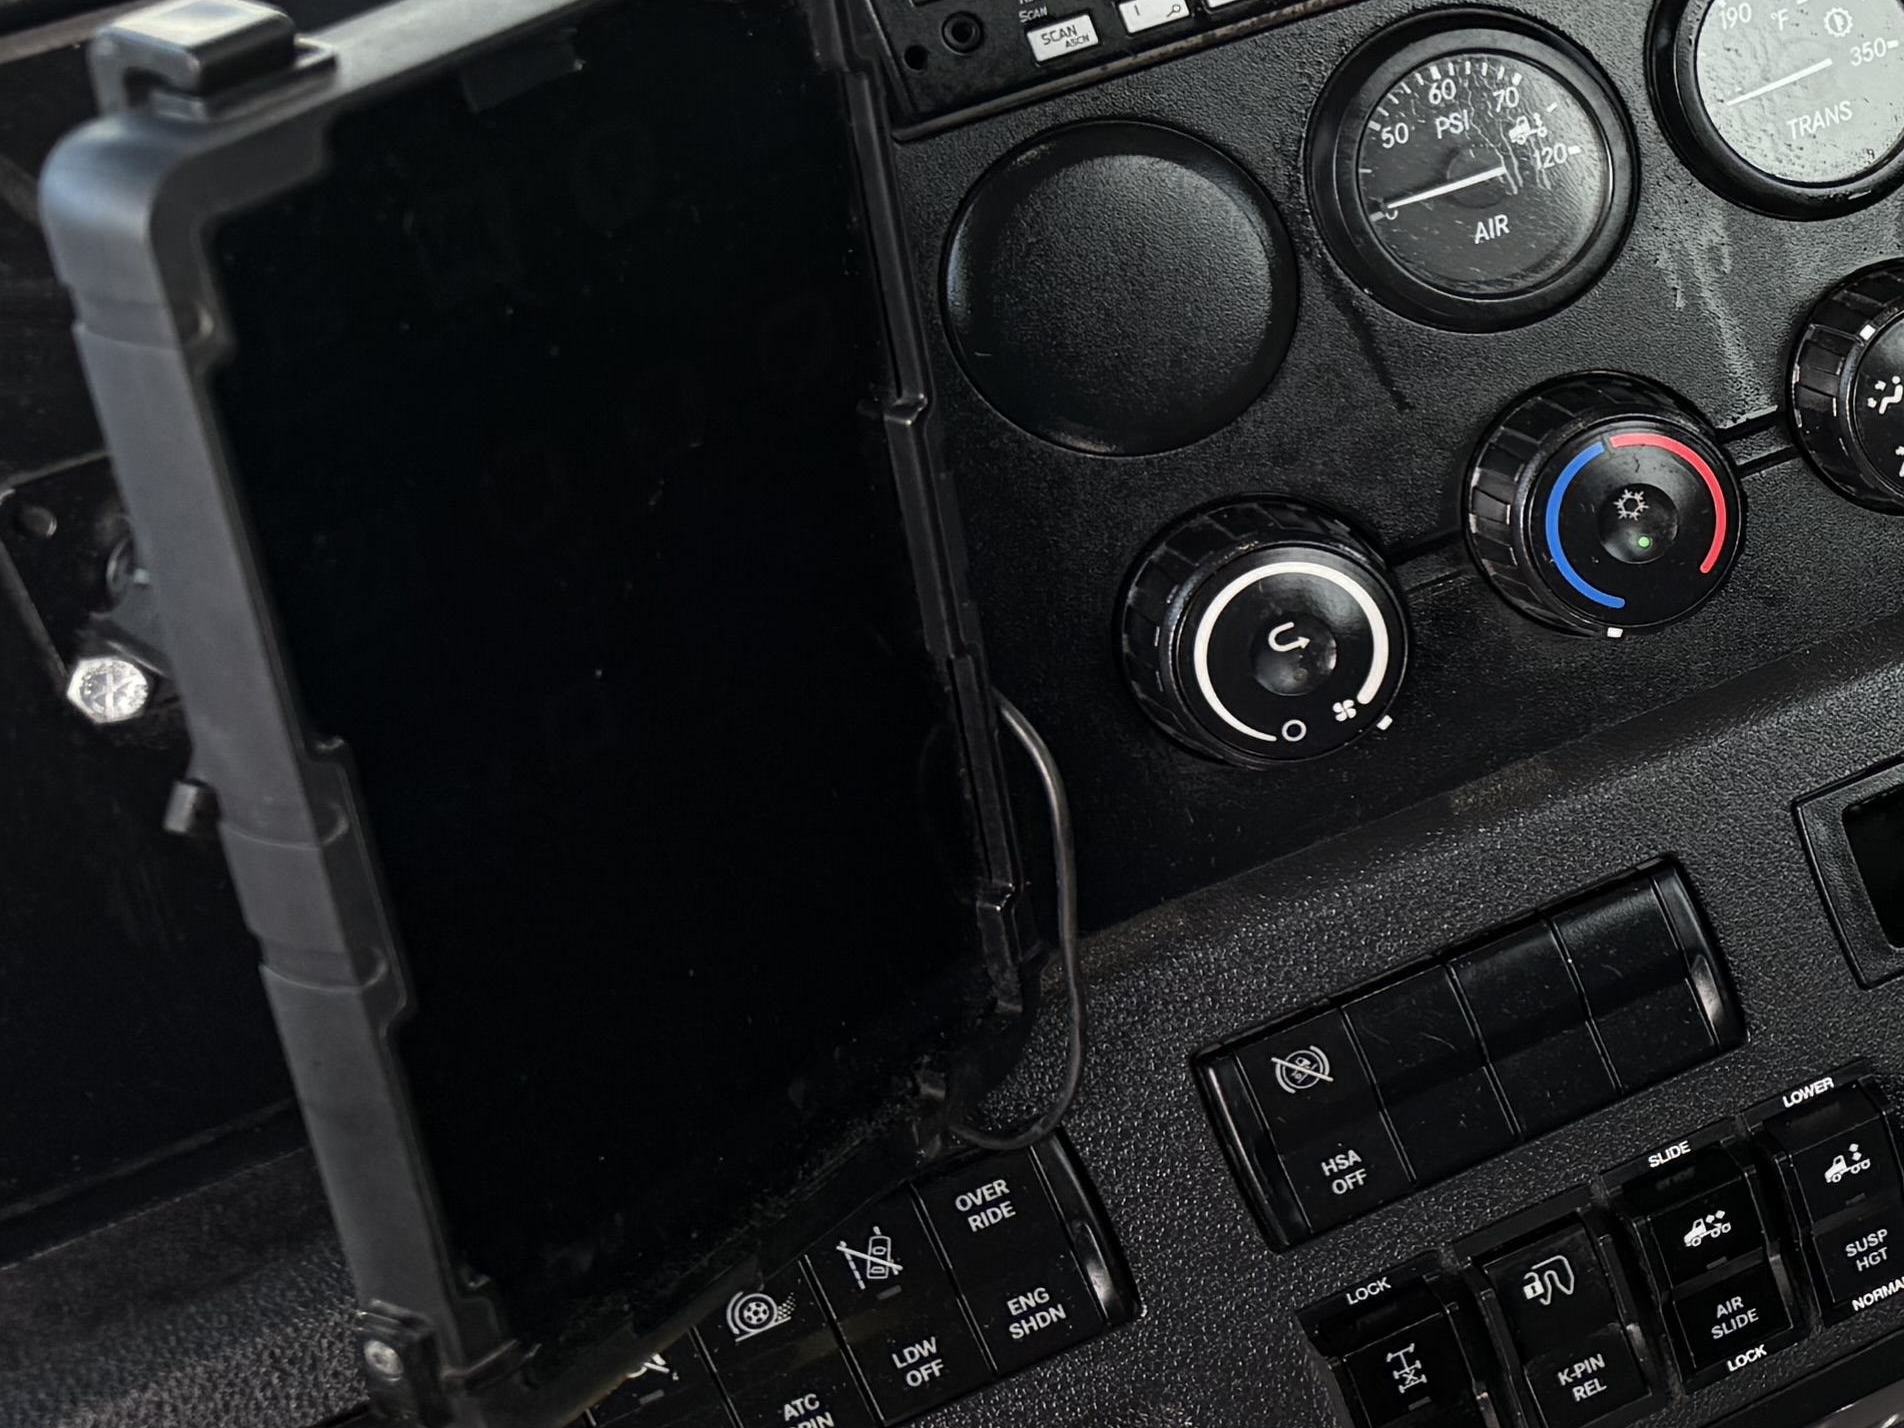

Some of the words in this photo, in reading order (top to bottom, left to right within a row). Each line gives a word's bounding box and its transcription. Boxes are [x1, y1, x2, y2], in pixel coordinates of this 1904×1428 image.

[1718, 2, 1752, 30] 190
[1040, 24, 1078, 46] SCAN
[1850, 37, 1887, 67] 350
[1428, 78, 1457, 105] 60
[1492, 86, 1520, 113] 70
[1435, 109, 1470, 139] PSI
[1786, 100, 1853, 140] TRANS
[1380, 122, 1410, 149] 50
[1534, 142, 1568, 170] 120
[1474, 214, 1510, 244] AIR
[1782, 1076, 1835, 1109] LOWER
[1321, 1149, 1362, 1177] HSA
[1648, 1141, 1691, 1169] SLIDE
[954, 1178, 1010, 1214] OVER
[1331, 1168, 1367, 1195] OFF
[967, 1200, 1017, 1233] RIDE
[1845, 1228, 1889, 1258] SUSP
[1856, 1247, 1889, 1272] HGT
[1006, 1286, 1050, 1318] ENG
[1345, 1276, 1392, 1306] LOCK
[1008, 1302, 1067, 1341] SHDN
[1715, 1296, 1745, 1319] AIR
[1711, 1308, 1760, 1340] SLIDE
[891, 1337, 938, 1370] LDW
[1727, 1344, 1768, 1373] LOCK
[905, 1358, 945, 1390] OFF
[1556, 1353, 1606, 1386] K-PIN
[1572, 1377, 1608, 1402] REL
[783, 1392, 821, 1423] ATC
